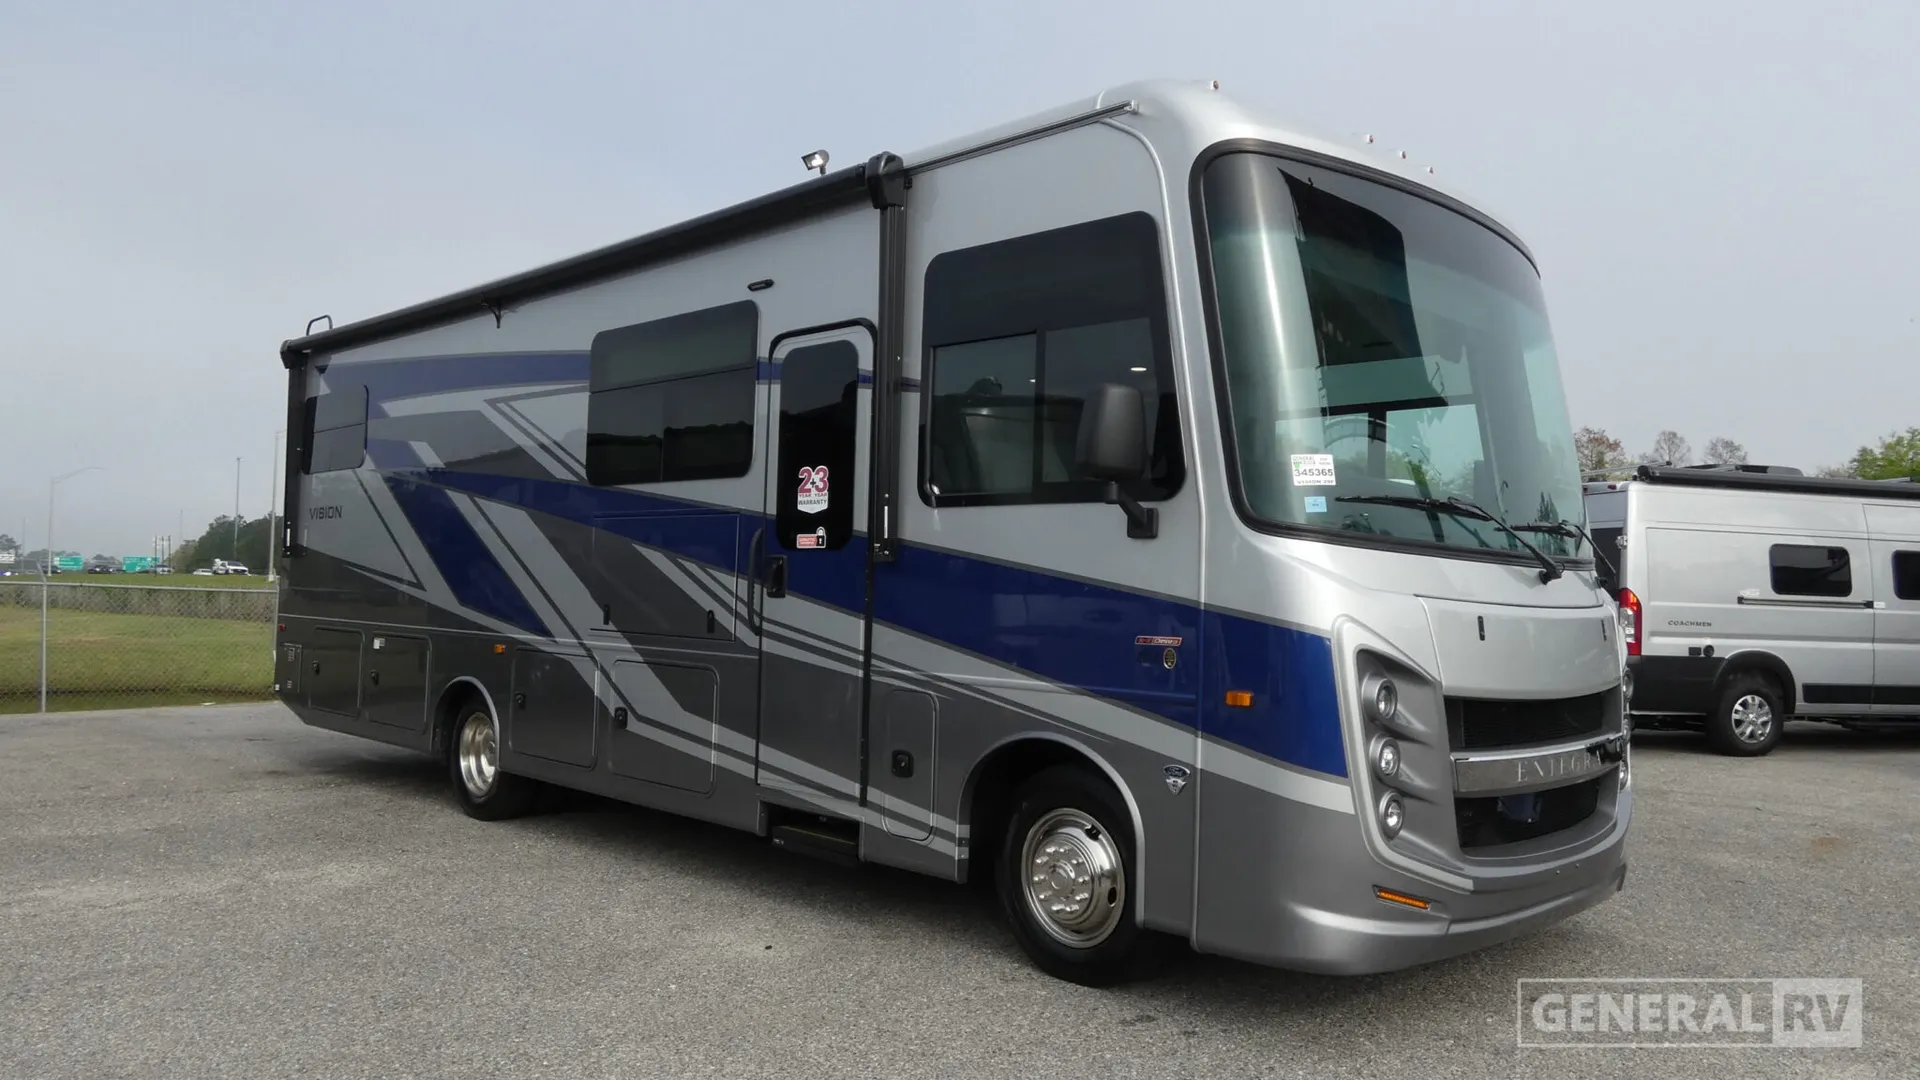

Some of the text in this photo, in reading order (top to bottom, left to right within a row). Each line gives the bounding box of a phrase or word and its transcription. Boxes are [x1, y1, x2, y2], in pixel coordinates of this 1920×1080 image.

[1294, 468, 1334, 477] 345365
[309, 505, 343, 520] VISION
[1667, 619, 1712, 627] COACHMEN
